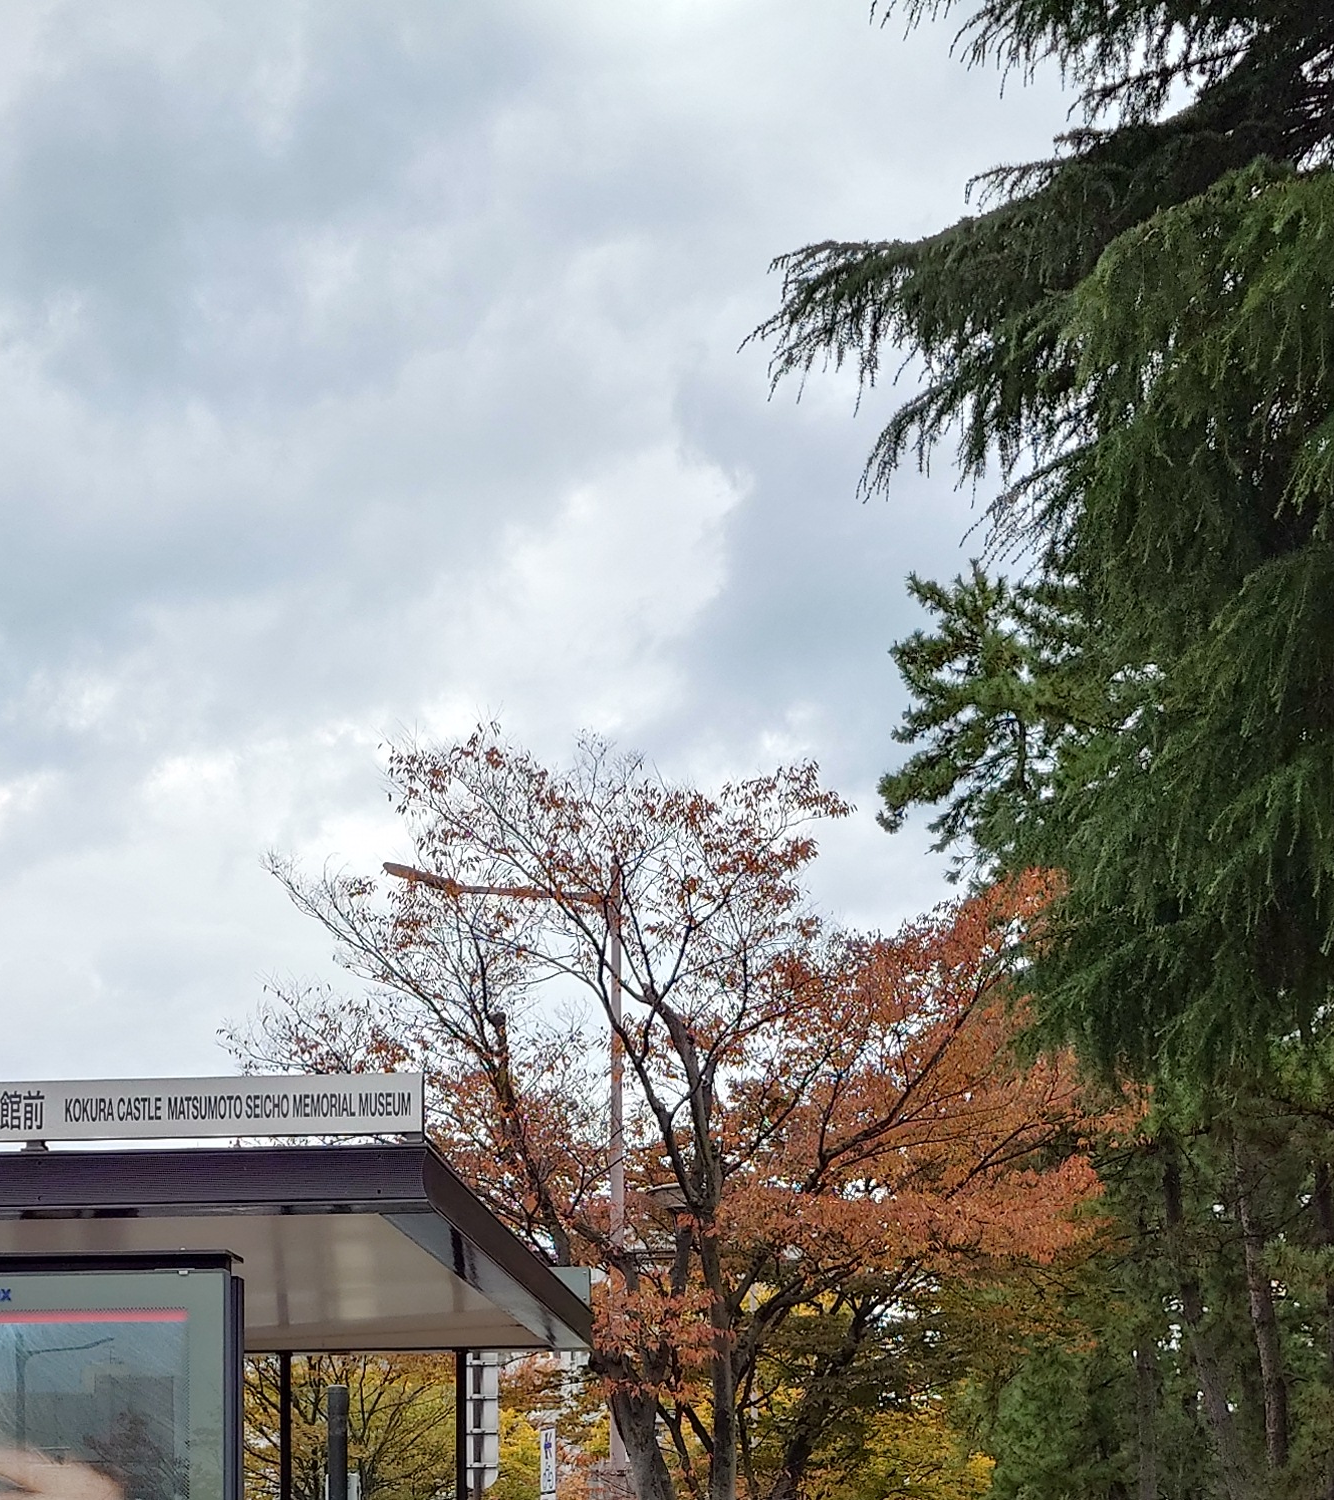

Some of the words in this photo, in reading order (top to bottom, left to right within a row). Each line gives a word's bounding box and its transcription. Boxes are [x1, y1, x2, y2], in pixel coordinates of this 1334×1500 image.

[64, 1097, 115, 1123] KOKURA
[116, 1096, 162, 1122] CASTLE
[167, 1094, 243, 1121] MATSUMOTO
[244, 1093, 290, 1119] SEICHO
[292, 1092, 356, 1118] MEMORIAL
[358, 1091, 412, 1117] MUSEUM
